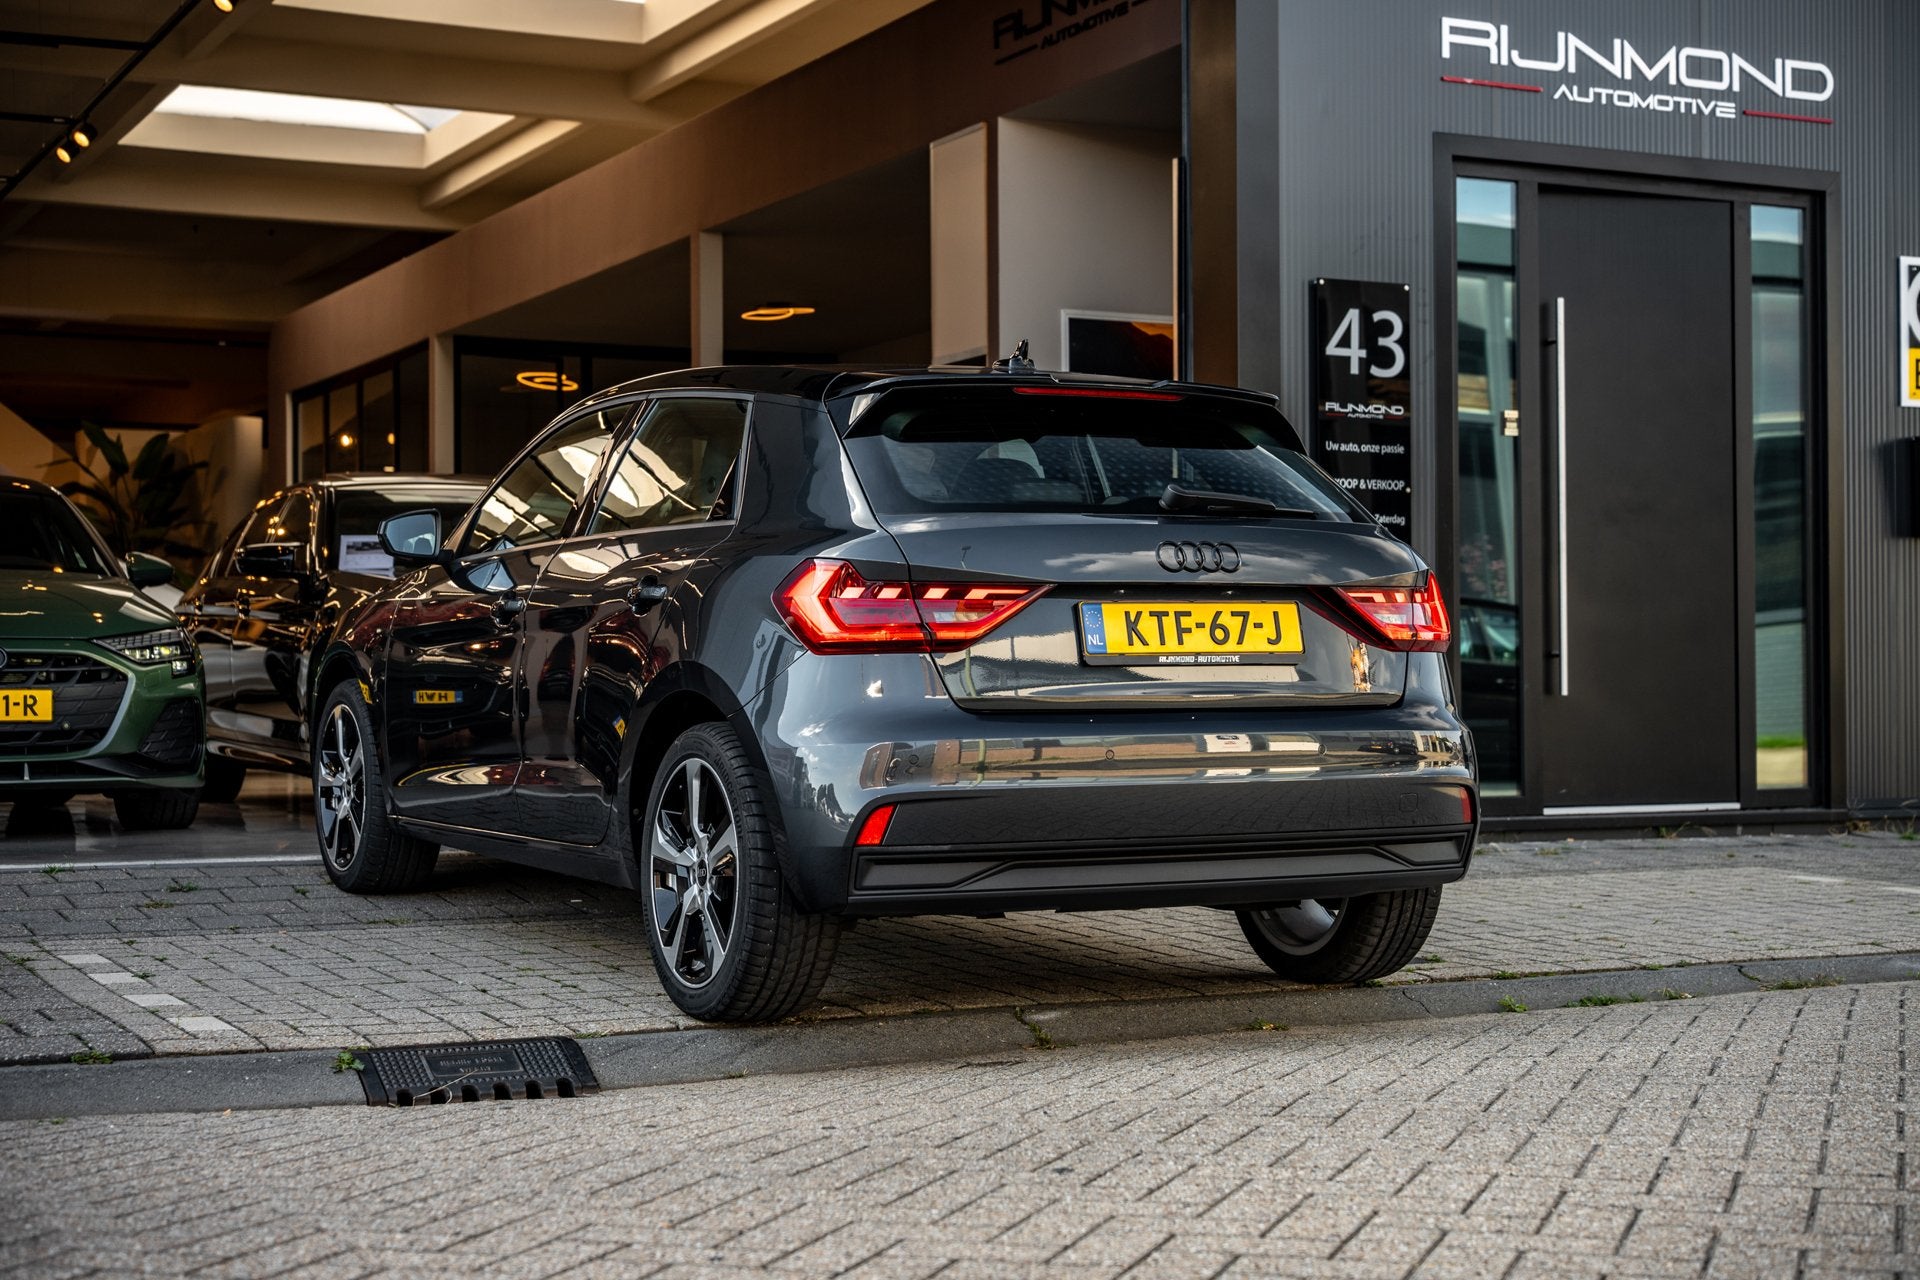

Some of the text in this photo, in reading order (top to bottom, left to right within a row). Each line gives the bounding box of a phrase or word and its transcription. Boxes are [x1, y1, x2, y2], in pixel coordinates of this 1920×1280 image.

[1040, 2, 1130, 49] AUTOMOTIVE
[1441, 16, 1834, 102] RIJNMOND
[1553, 83, 1736, 119] AUTOMOTIVE
[1325, 308, 1405, 378] 43
[1325, 402, 1404, 416] RIJNMOND
[1325, 440, 1404, 455] Uw auto, onze passie
[1359, 478, 1367, 490] &
[1366, 478, 1405, 491] VERKOOP
[1374, 513, 1406, 526] Zaterdag
[1088, 634, 1103, 646] NL
[1124, 610, 1282, 646] KTF-67-J
